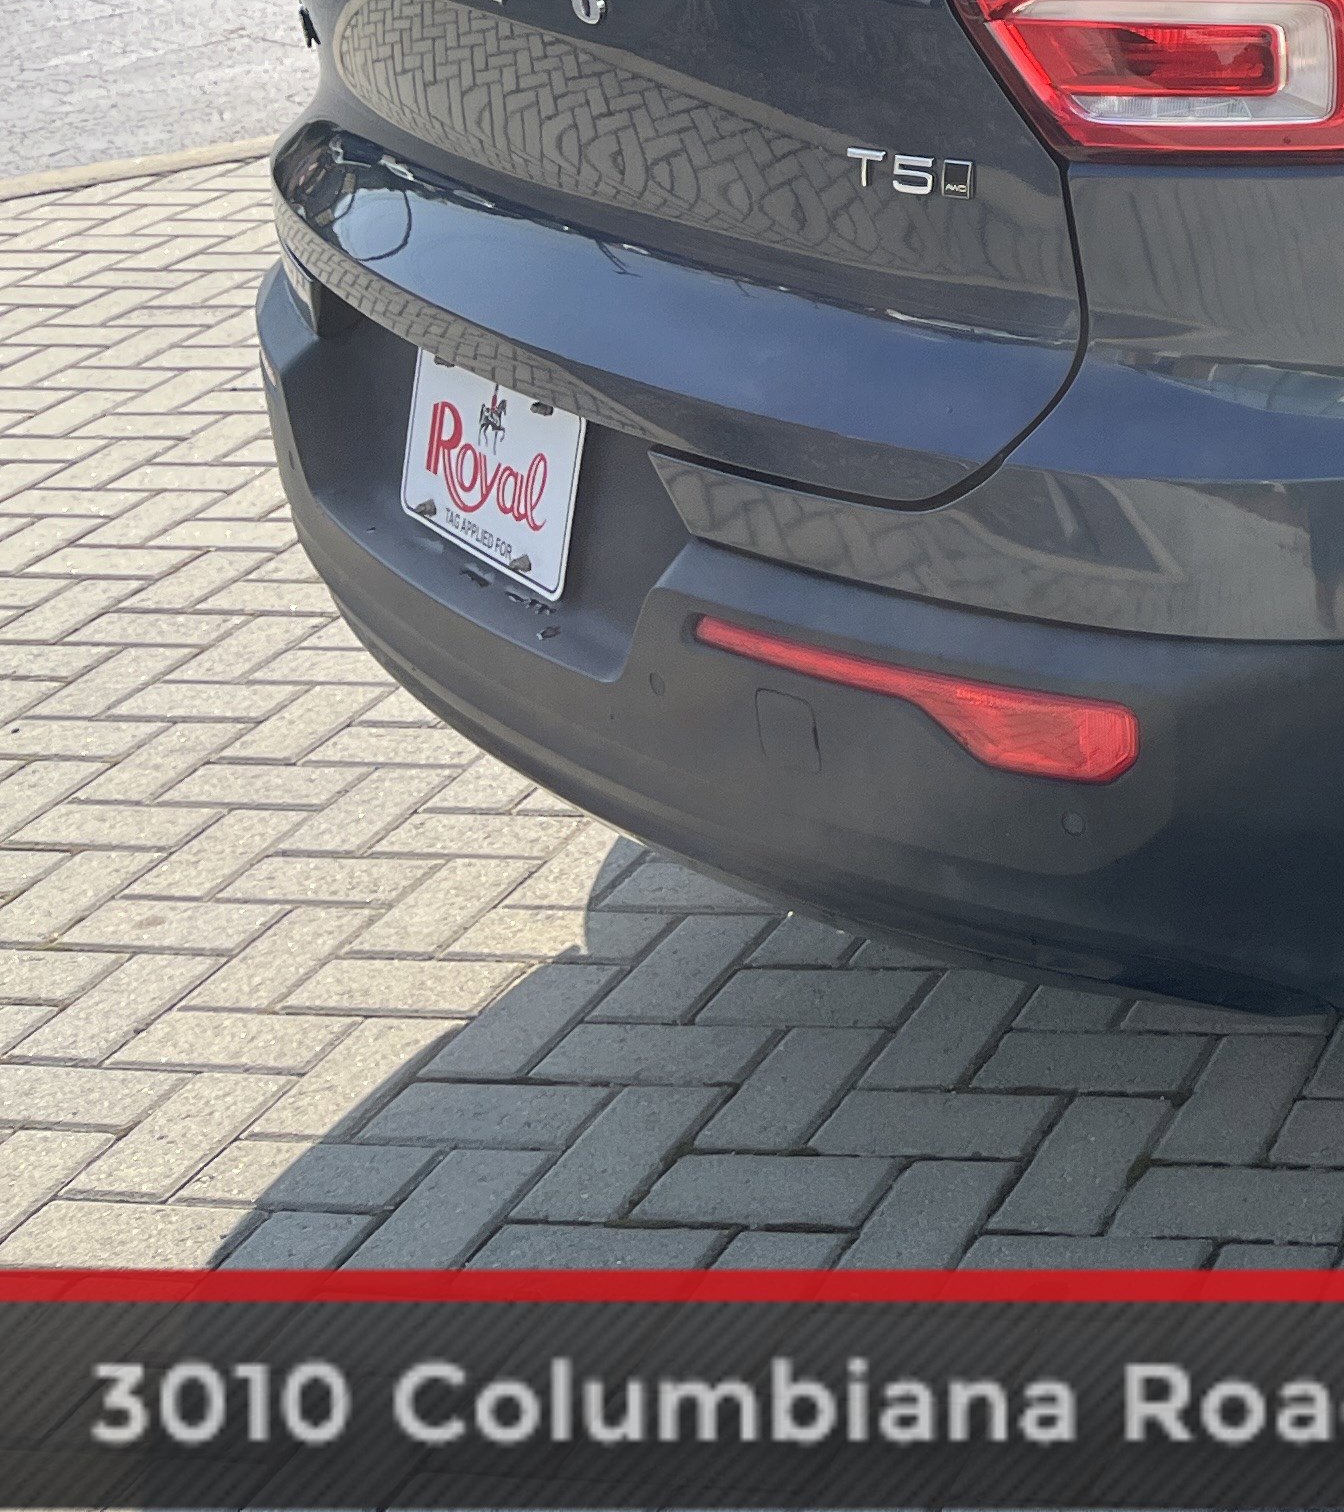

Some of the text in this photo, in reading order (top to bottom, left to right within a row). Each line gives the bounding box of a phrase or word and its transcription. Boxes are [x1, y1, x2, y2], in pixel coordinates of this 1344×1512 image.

[846, 146, 935, 195] T5
[426, 400, 547, 531] Royal
[445, 507, 513, 561] TAG APPLIED FOR
